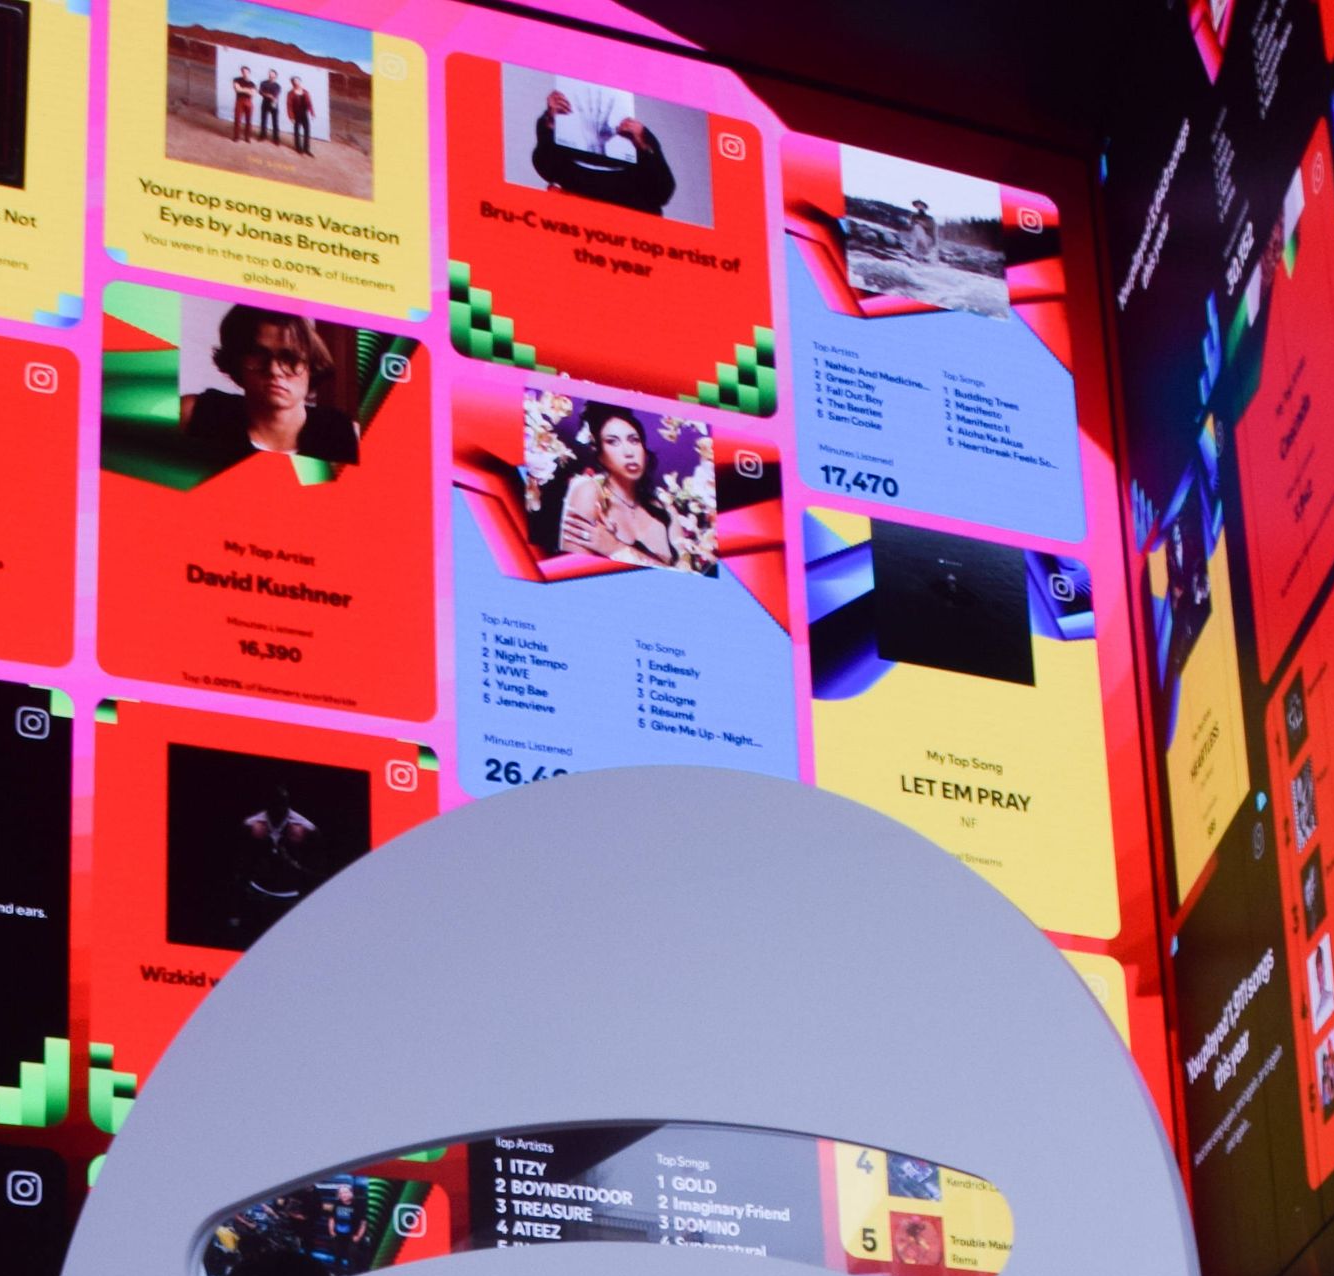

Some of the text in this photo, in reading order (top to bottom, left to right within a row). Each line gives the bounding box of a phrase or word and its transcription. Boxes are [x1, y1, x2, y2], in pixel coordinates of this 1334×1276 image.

[3, 208, 37, 228] Not
[138, 177, 400, 245] Your top song was Vacation
[159, 205, 380, 265] Eyes by Jonas Brothers
[479, 199, 741, 273] Bru-C was your top artist of
[572, 247, 653, 277] the year
[818, 464, 899, 498] 17,470
[186, 563, 352, 608] David Kushner
[238, 639, 303, 663] 16,390
[494, 633, 549, 653] Kali Uchis
[494, 648, 568, 671] Night Tempo
[494, 664, 529, 680] WWE
[648, 674, 676, 689] Paris
[495, 679, 548, 698] Yung Bae
[925, 749, 1004, 776] My Top Song
[900, 774, 1031, 812] LET EM PRAY
[14, 905, 48, 919] ears.
[139, 964, 207, 988] Wizkid
[509, 1158, 547, 1177] ITZY
[509, 1178, 635, 1207] BOYNEXTDOOR
[671, 1175, 717, 1194] GOLD
[511, 1199, 594, 1223] TREASURE
[511, 1220, 562, 1240] ATEEZ
[673, 1215, 741, 1237] DOMINO
[861, 1227, 877, 1253] 5
